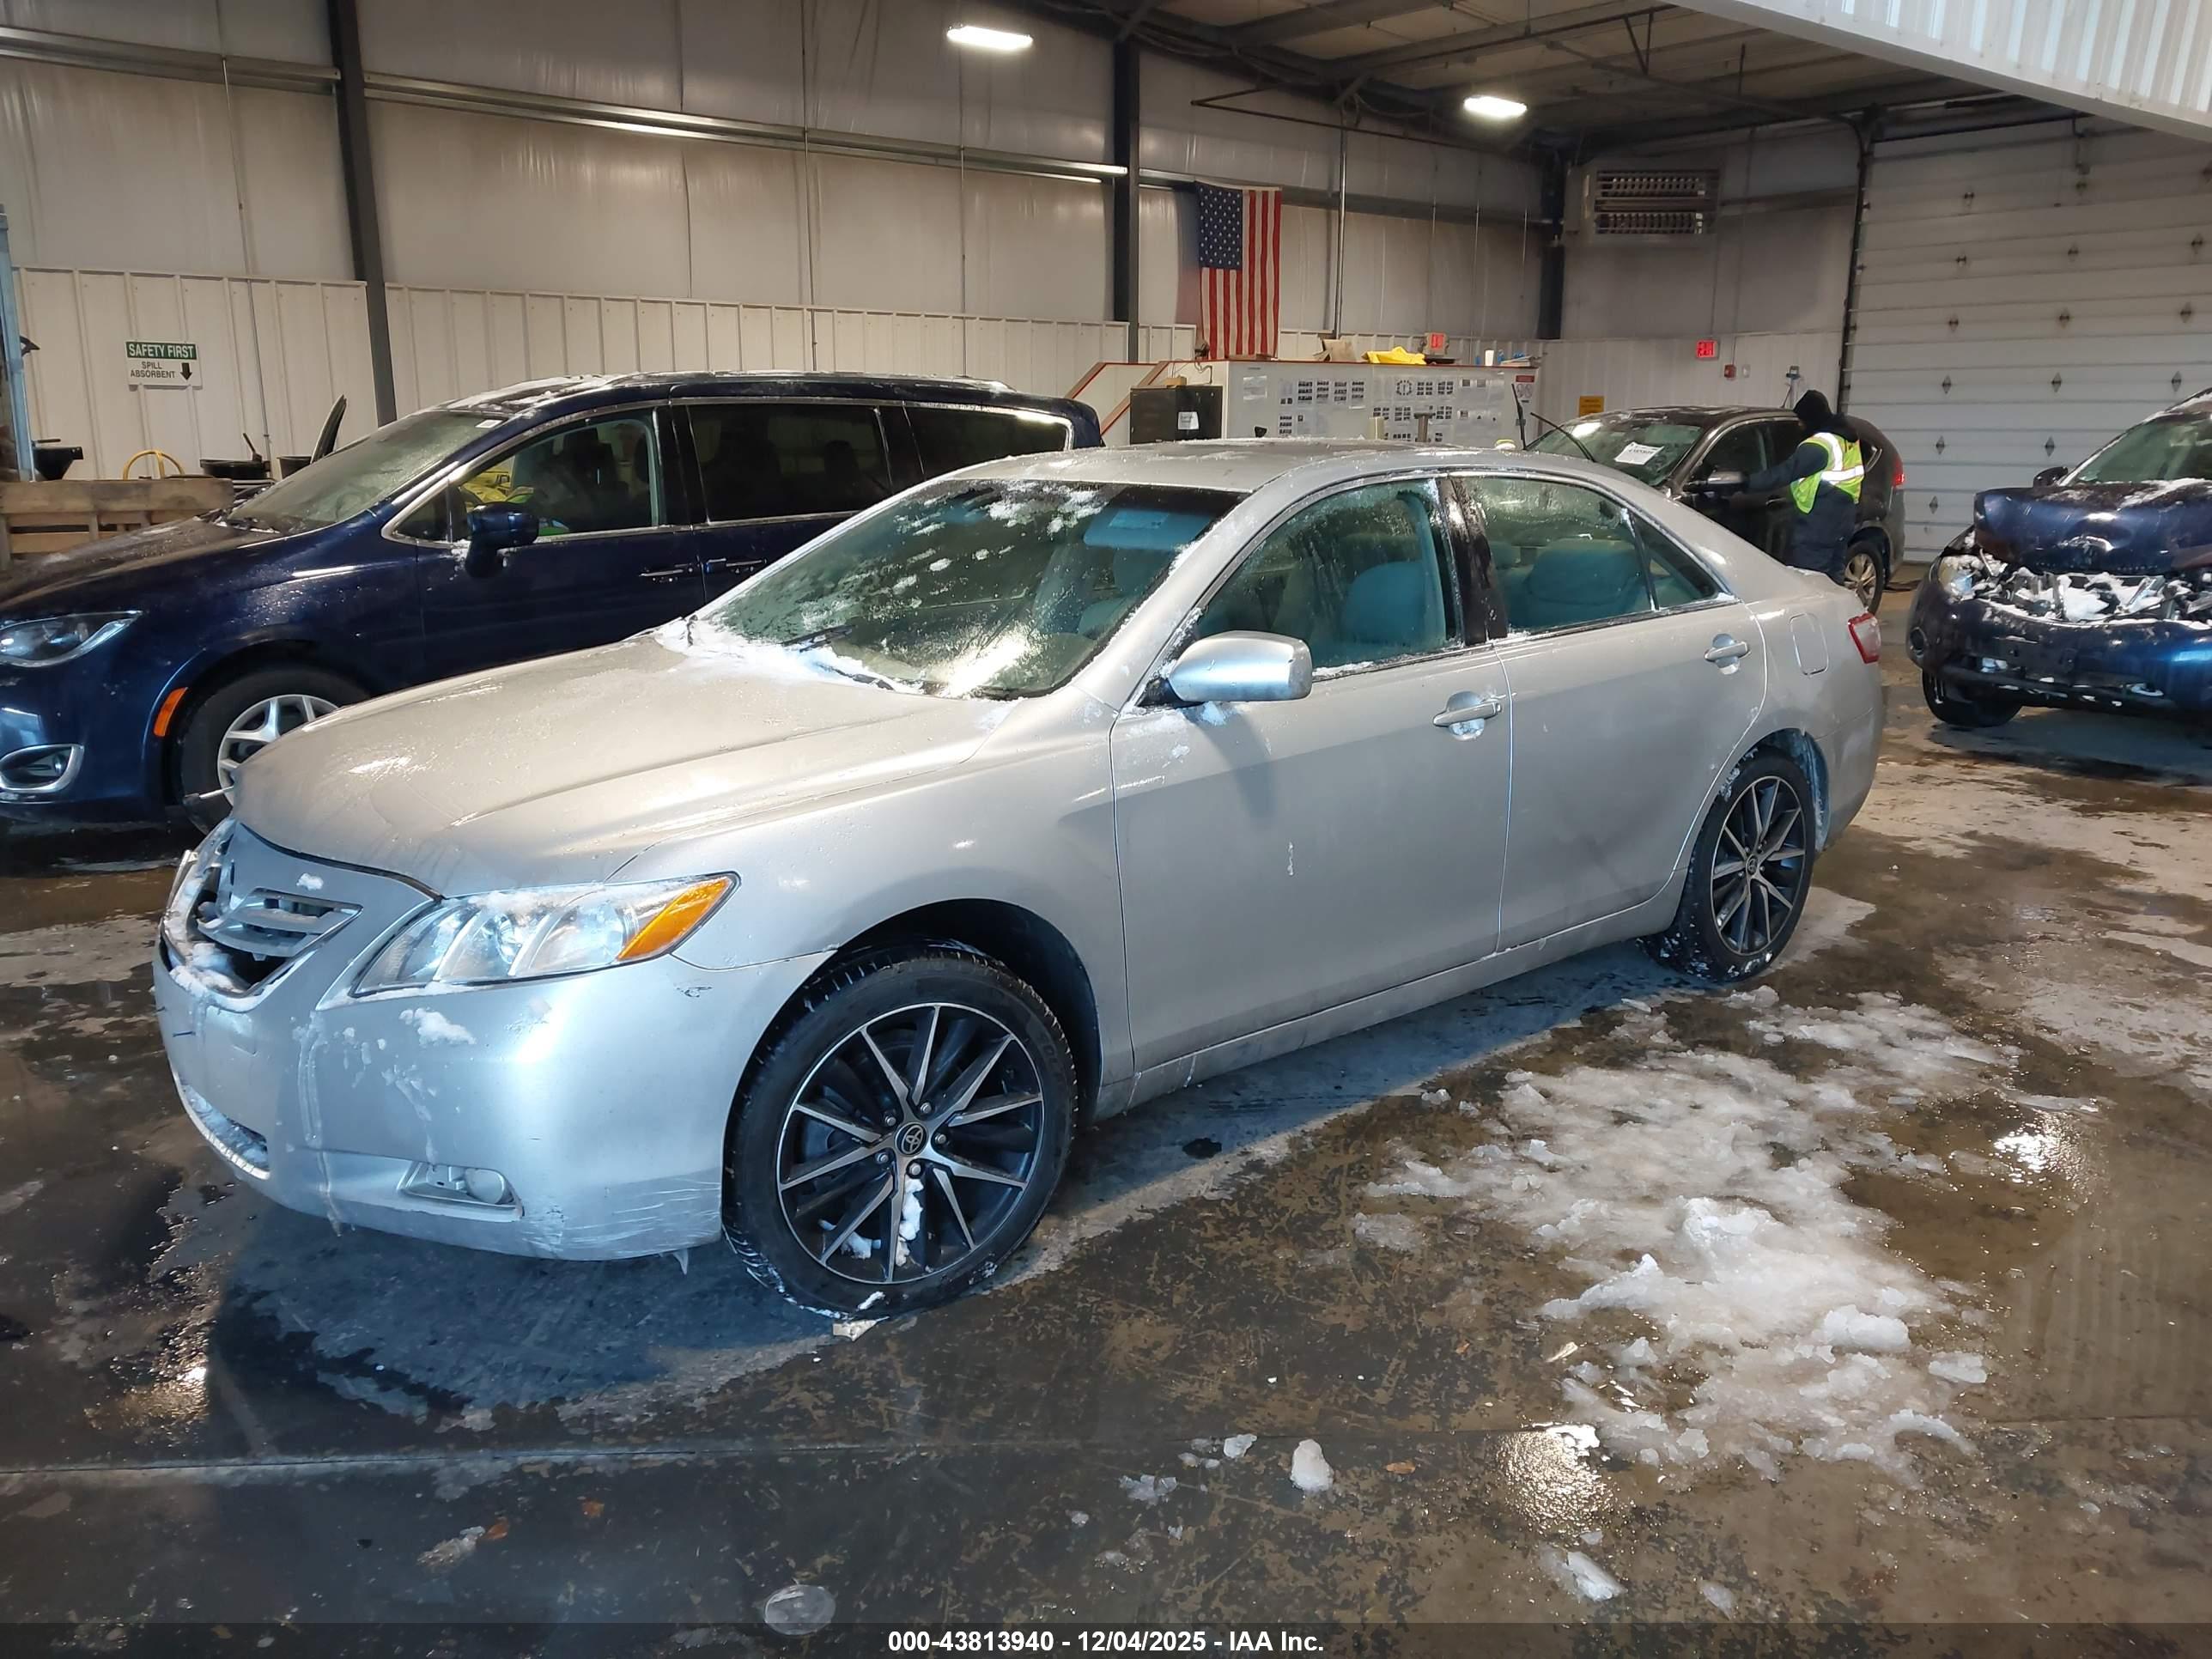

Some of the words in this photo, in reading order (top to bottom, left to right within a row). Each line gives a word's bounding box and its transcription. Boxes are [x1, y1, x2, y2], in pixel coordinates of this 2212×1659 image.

[129, 344, 164, 357] SAFETY
[167, 345, 193, 358] FIRST
[131, 369, 175, 379] ABSORBENT
